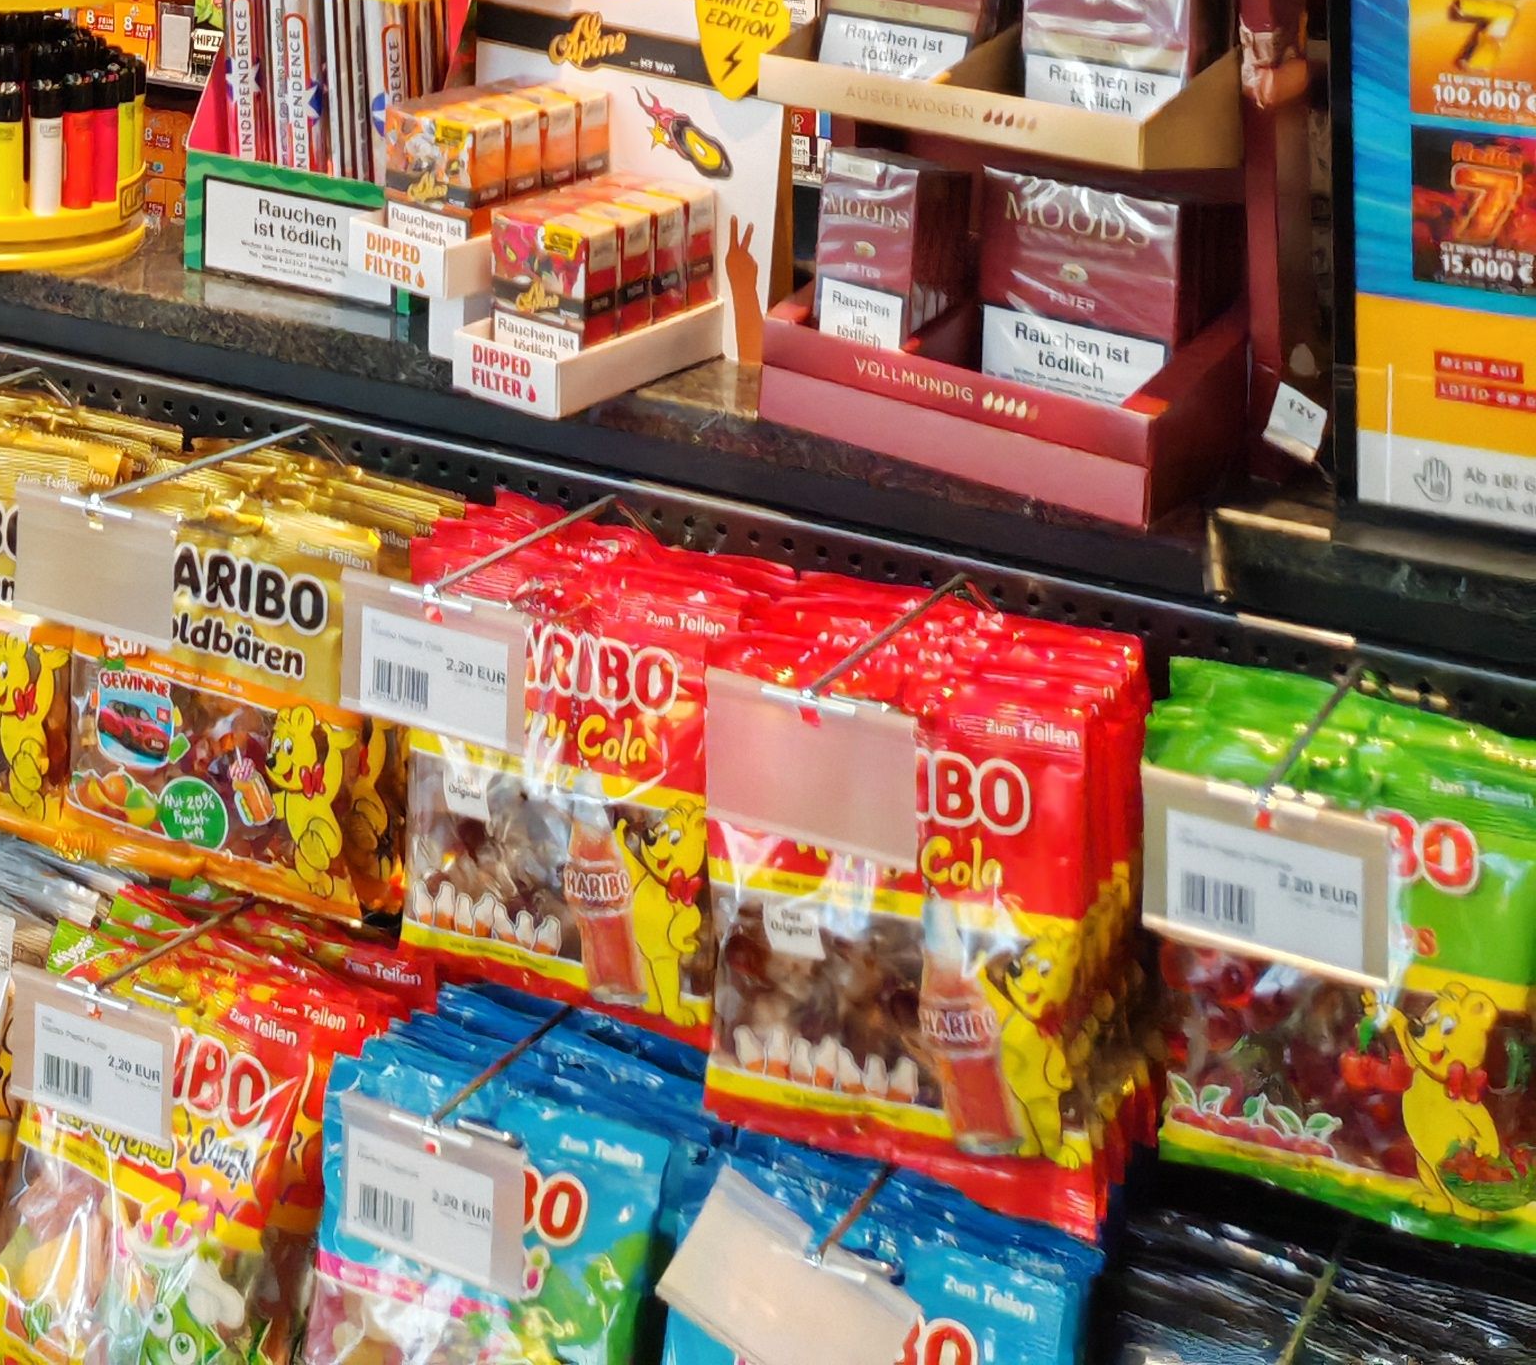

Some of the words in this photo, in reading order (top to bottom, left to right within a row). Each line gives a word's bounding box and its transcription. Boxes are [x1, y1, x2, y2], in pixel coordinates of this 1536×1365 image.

[705, 7, 776, 41] EDITION
[234, 8, 254, 153] INDEPENDENCE
[257, 197, 338, 231] Rauchen
[253, 220, 278, 239] ist
[280, 223, 343, 253] tödlich
[366, 230, 421, 266] DIPPED
[364, 252, 412, 286] FILTER
[472, 343, 531, 379] DIPPED
[471, 367, 522, 399] FILTER
[854, 355, 975, 403] VOLLMUNDIG
[172, 546, 327, 635] ARIBO
[646, 610, 674, 627] Zum
[99, 672, 171, 699] GEWINNE
[578, 714, 647, 765] Cola
[921, 836, 1003, 892] Cola
[564, 868, 631, 899] HARIBO
[135, 1063, 161, 1084] EUR
